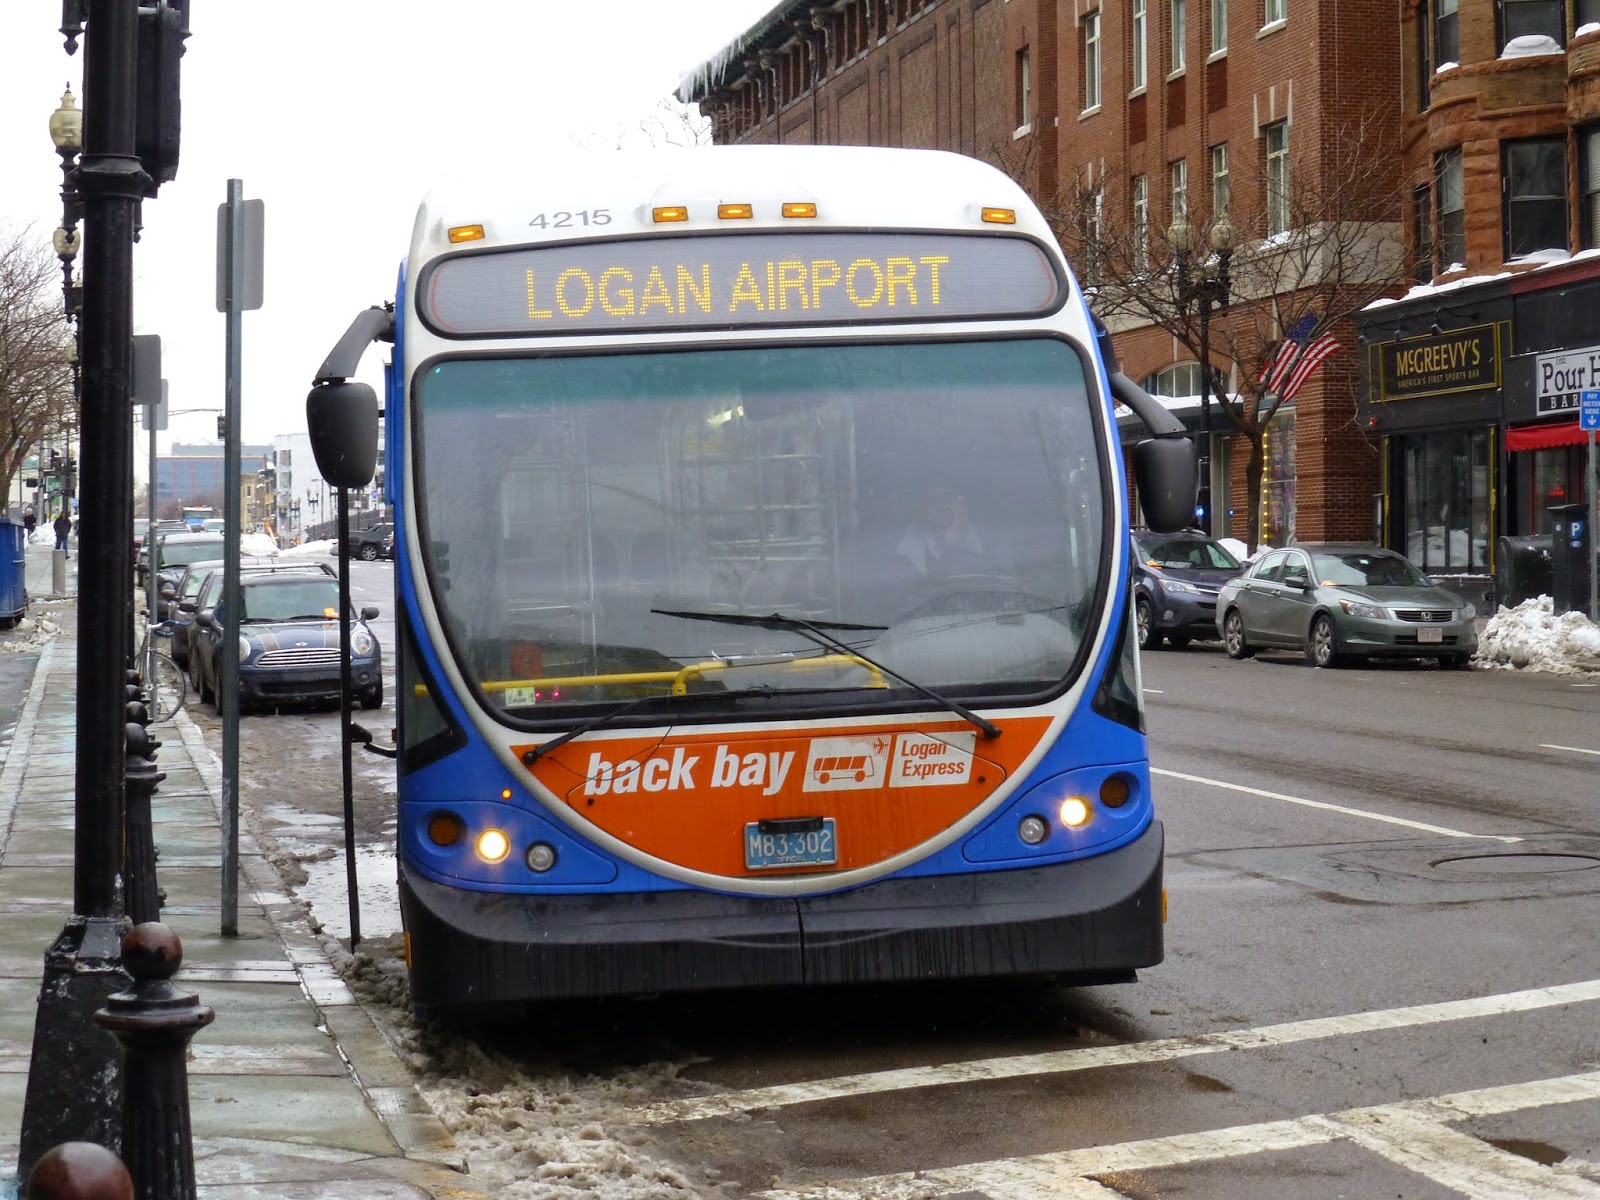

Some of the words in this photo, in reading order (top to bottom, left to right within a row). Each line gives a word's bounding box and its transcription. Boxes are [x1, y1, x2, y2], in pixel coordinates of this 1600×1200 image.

[528, 208, 613, 230] 4215
[526, 264, 712, 318] LOGAN
[729, 255, 950, 312] AIRPORT
[1428, 374, 1443, 384] FIRST
[1445, 371, 1467, 382] SPORTS
[1468, 368, 1481, 379] BAR
[1542, 362, 1586, 394] Pour
[901, 739, 948, 760] Logan
[583, 747, 700, 796] back
[710, 744, 796, 796] bay
[902, 759, 965, 780] Express
